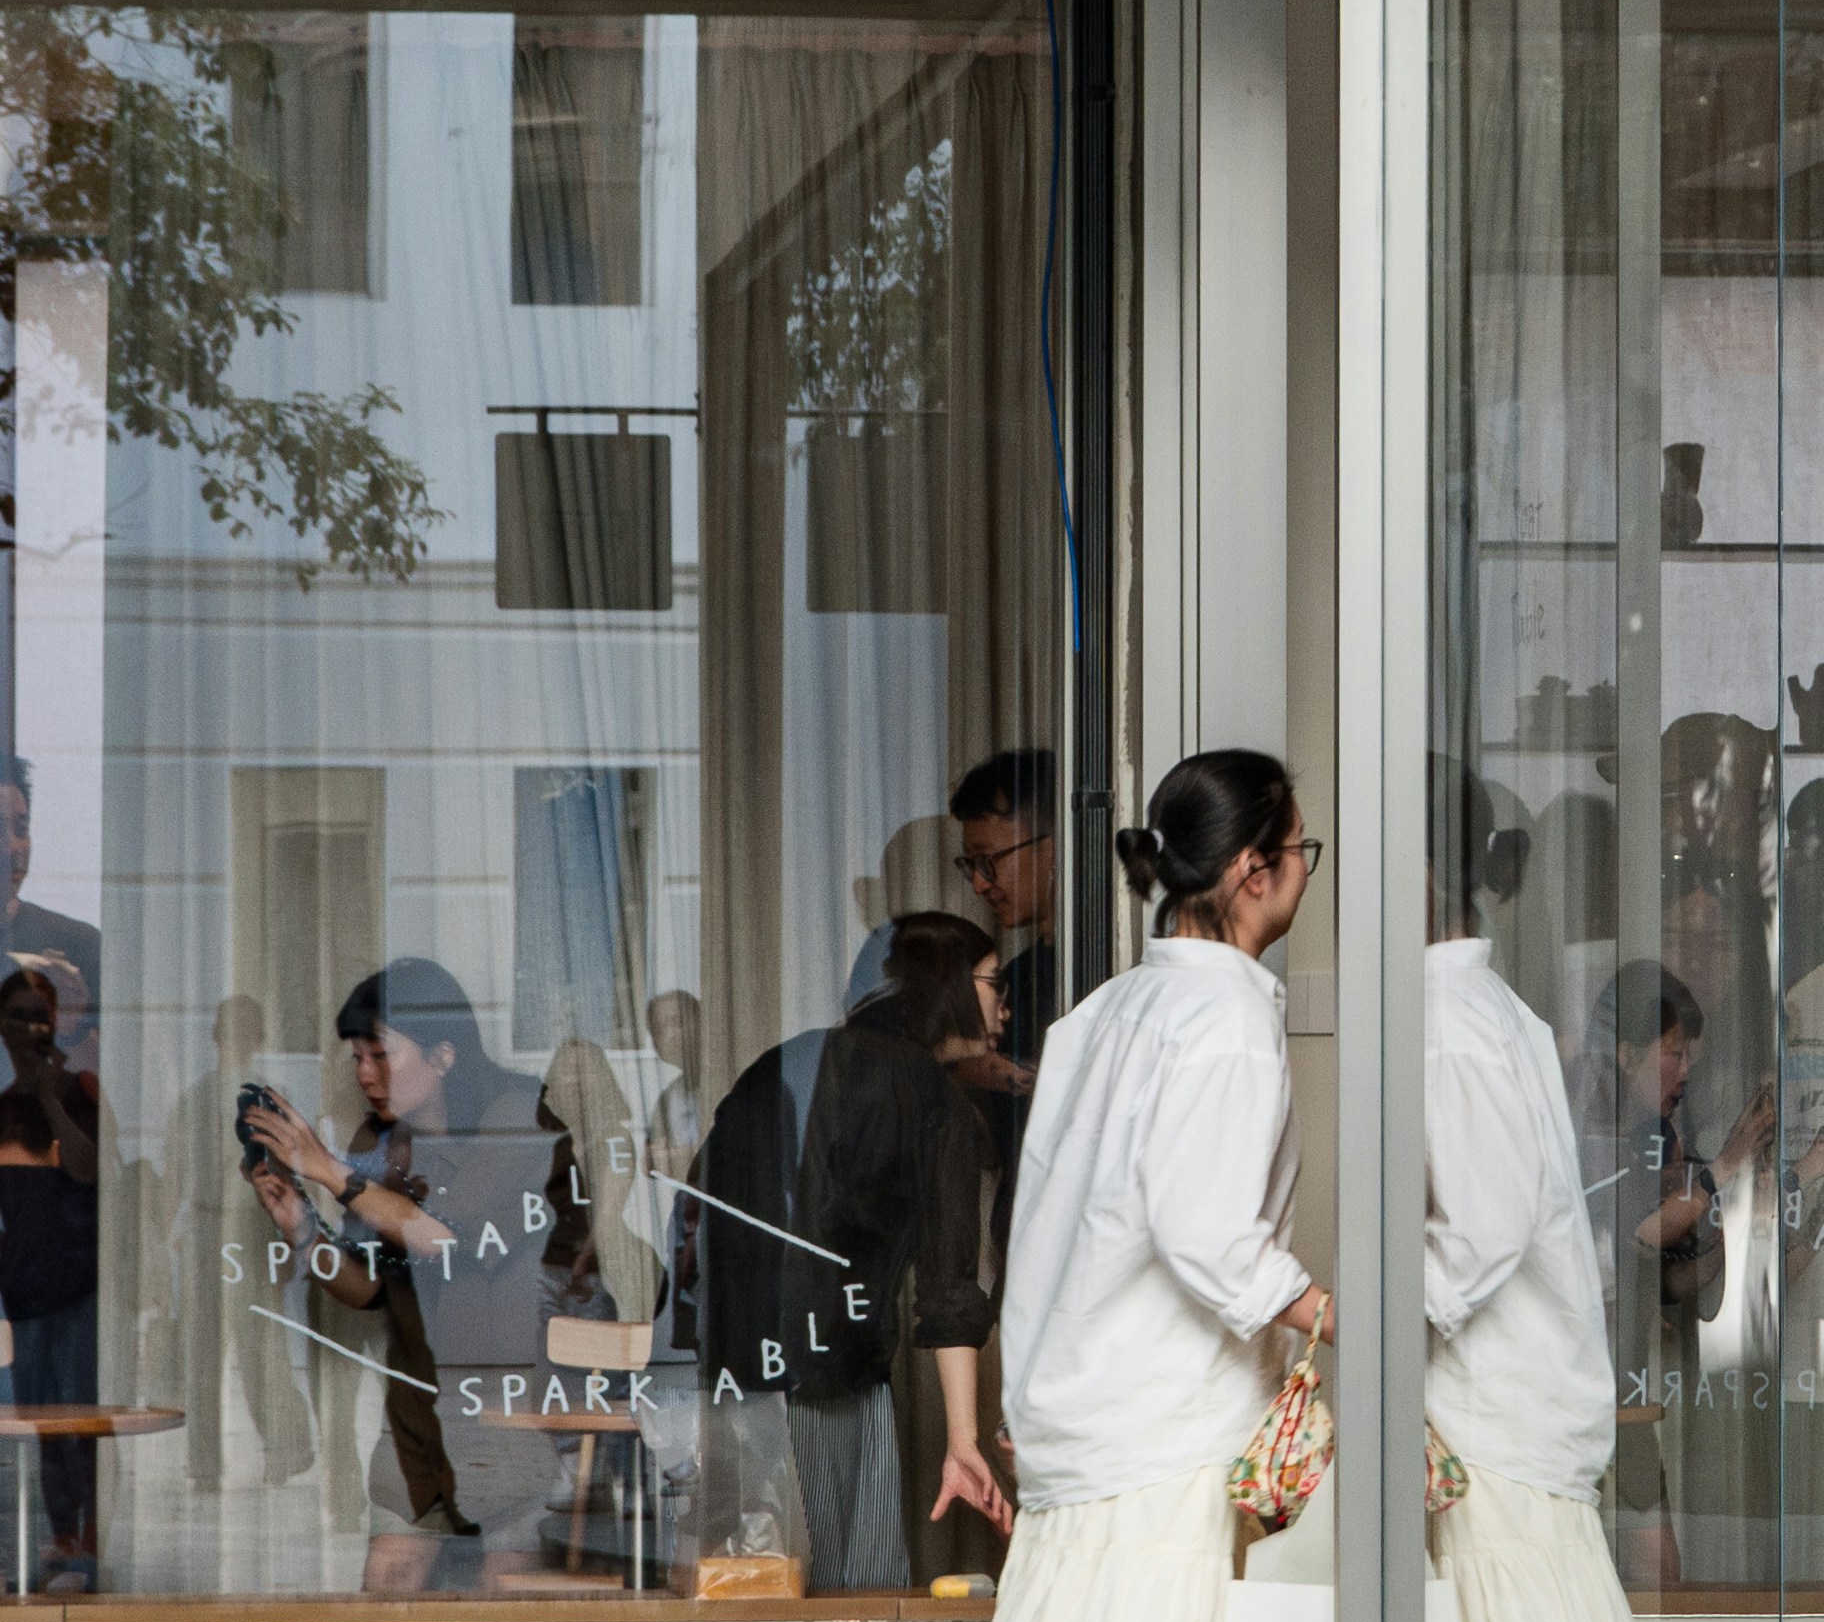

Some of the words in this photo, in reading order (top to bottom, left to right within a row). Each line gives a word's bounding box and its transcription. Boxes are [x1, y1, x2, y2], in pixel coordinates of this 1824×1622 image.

[220, 1240, 383, 1284] SPOT
[431, 1135, 634, 1282] TABLE
[457, 1374, 659, 1417] SPARK
[712, 1282, 871, 1405] ABLE
